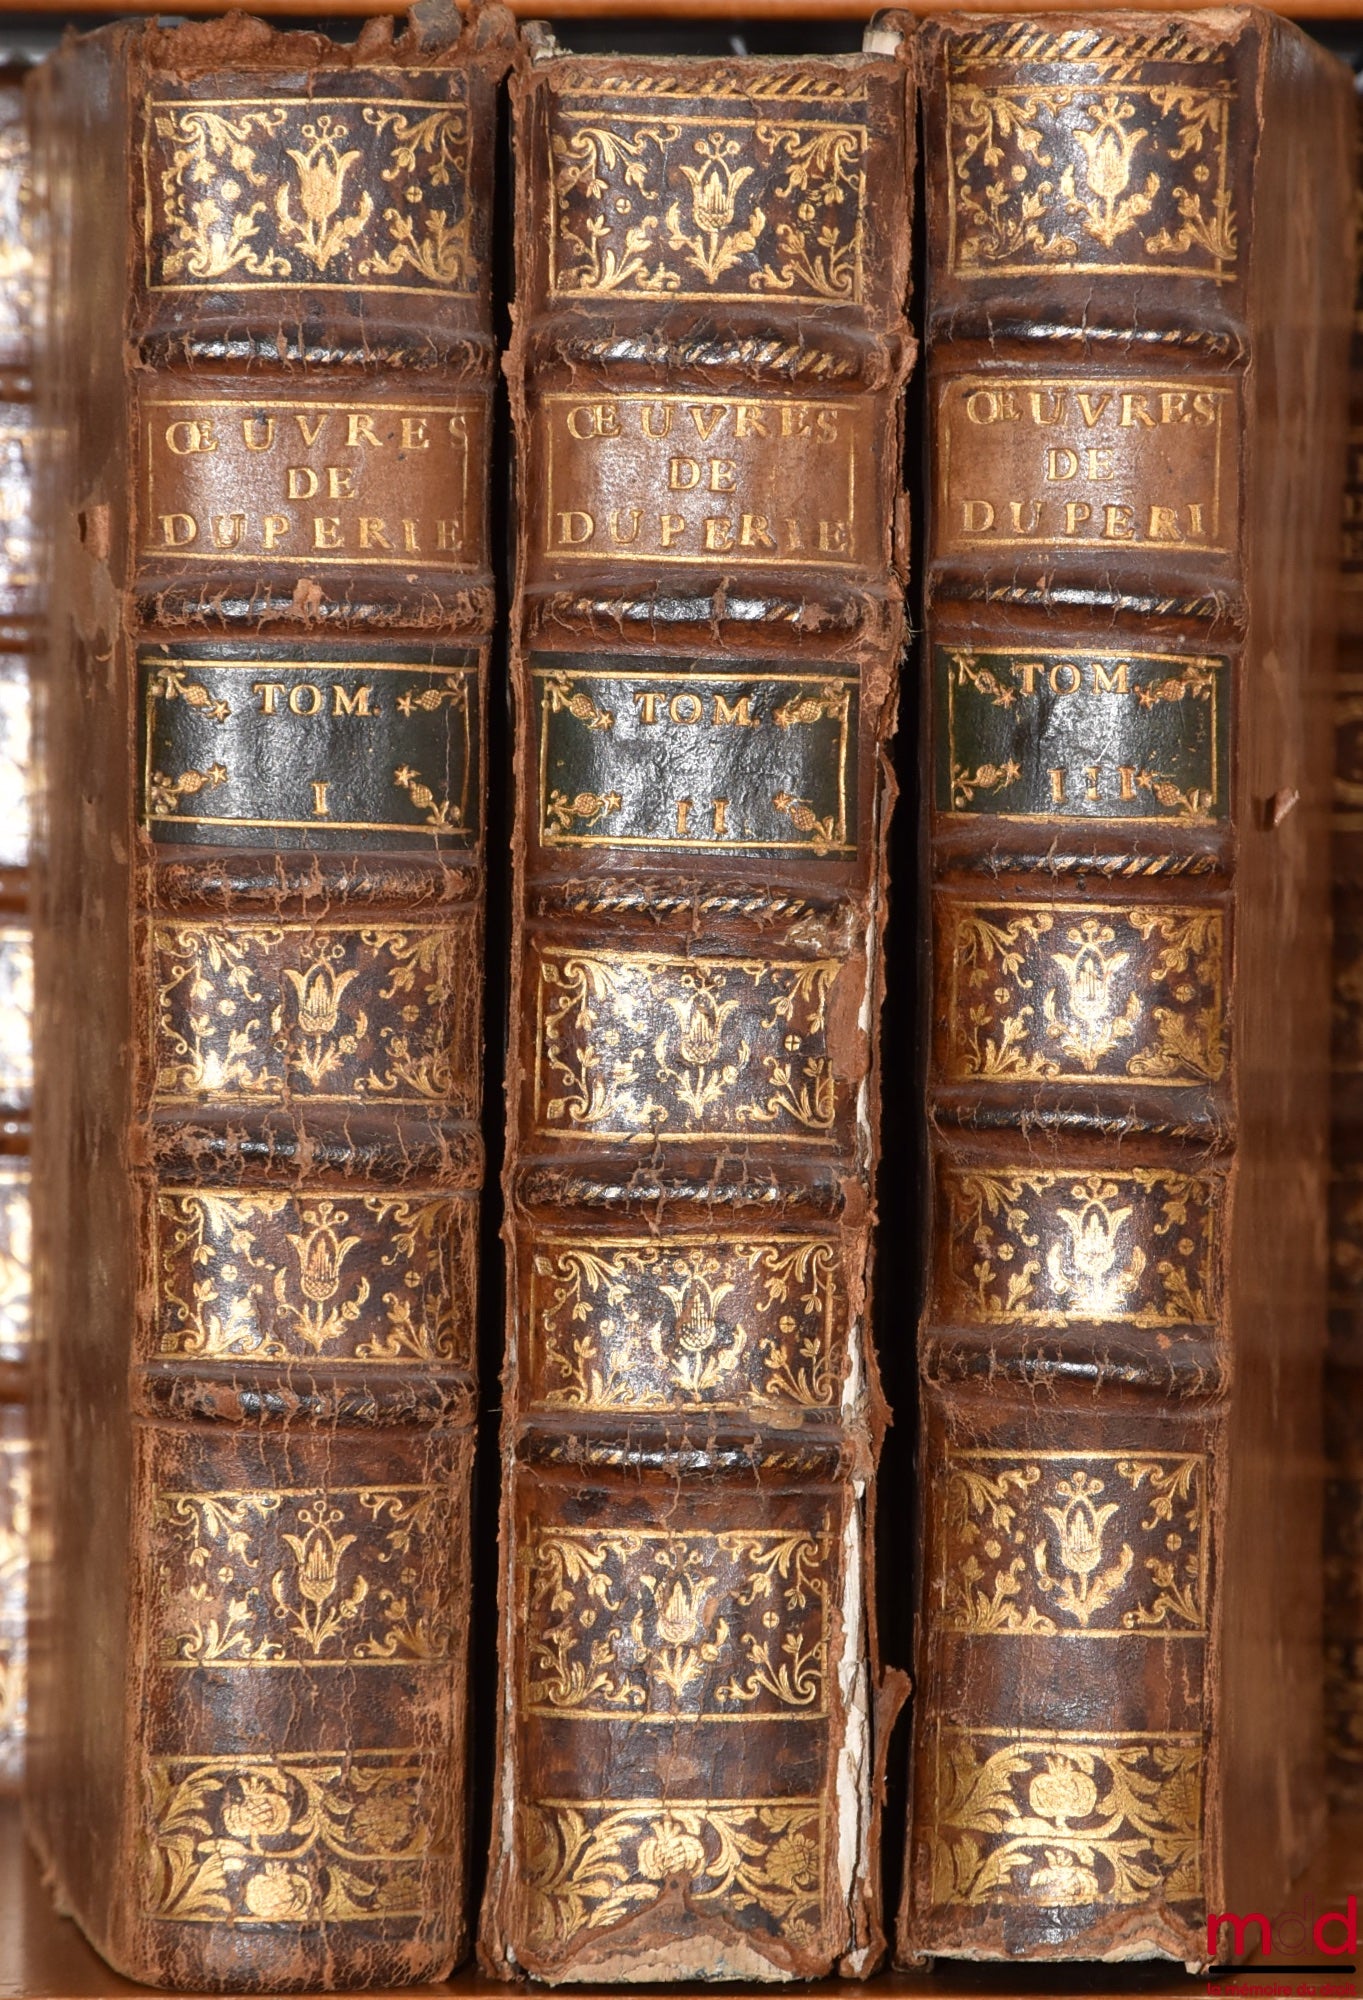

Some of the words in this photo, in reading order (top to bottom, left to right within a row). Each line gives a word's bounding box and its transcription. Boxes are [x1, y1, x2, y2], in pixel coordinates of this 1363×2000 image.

[668, 457, 738, 492] DE
[1047, 448, 1114, 481] DE
[287, 466, 355, 500] DE
[310, 780, 330, 816] I
[1047, 766, 1137, 804] III
